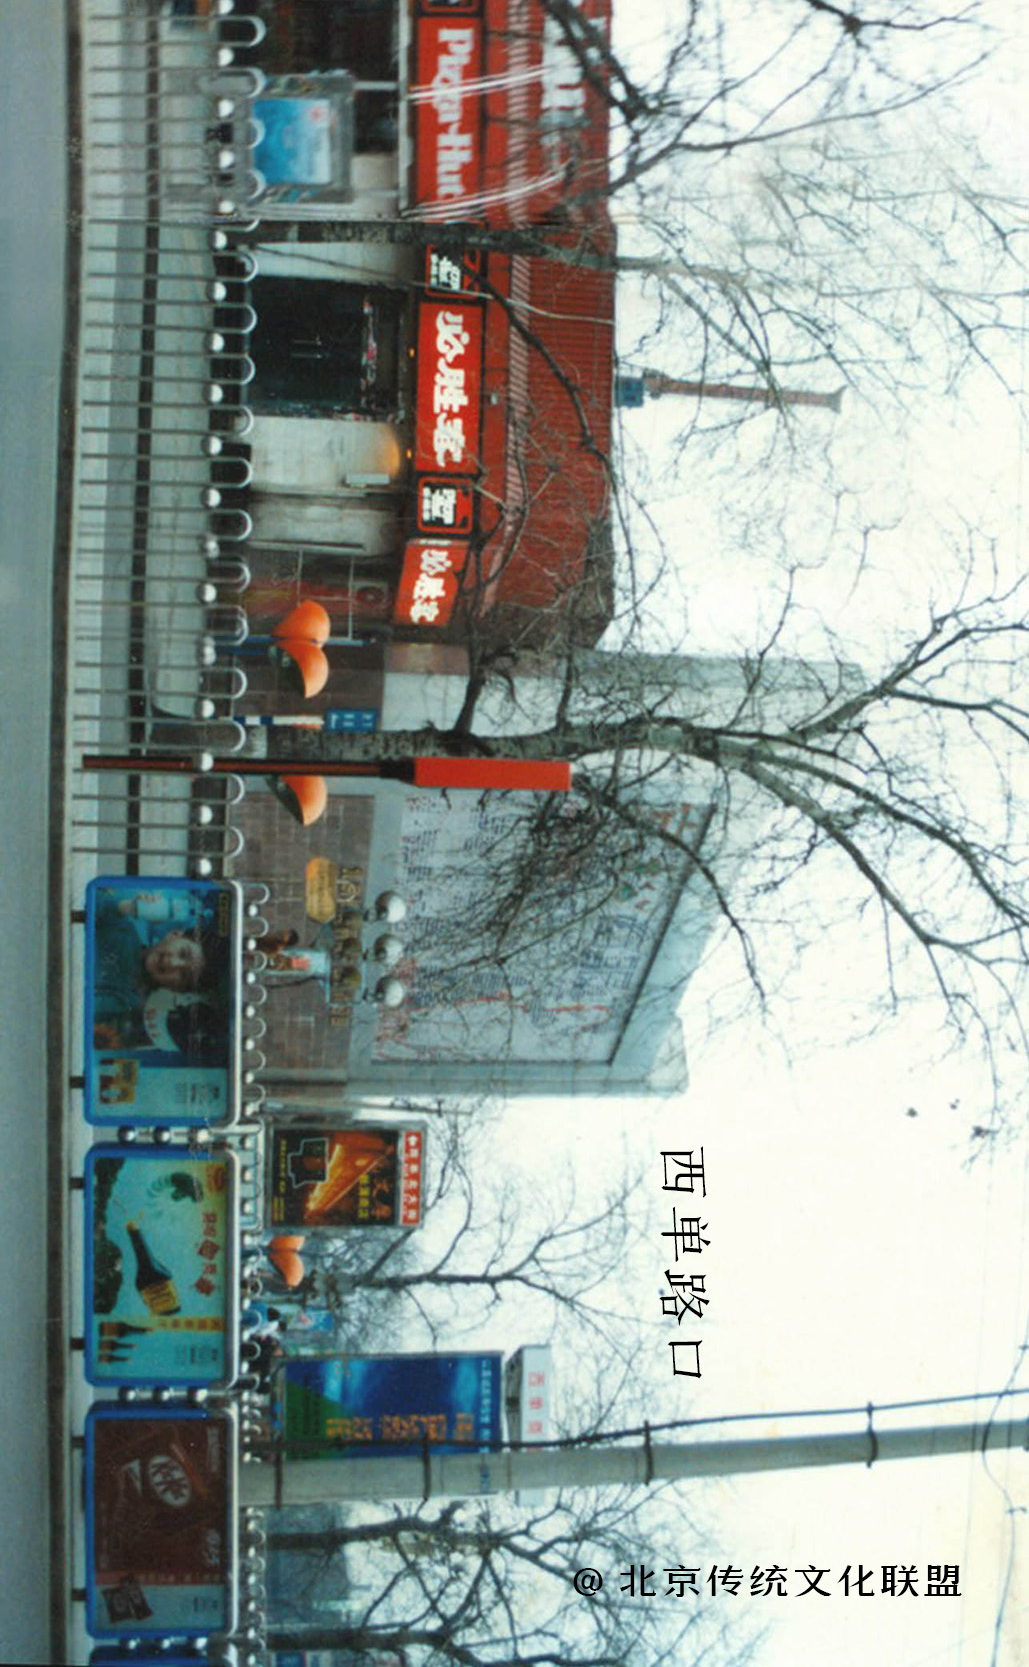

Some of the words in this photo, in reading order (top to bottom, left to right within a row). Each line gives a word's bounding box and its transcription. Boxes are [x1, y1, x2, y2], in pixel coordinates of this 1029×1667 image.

[433, 311, 471, 468] 必胜客
[409, 549, 453, 624] 必胜客
